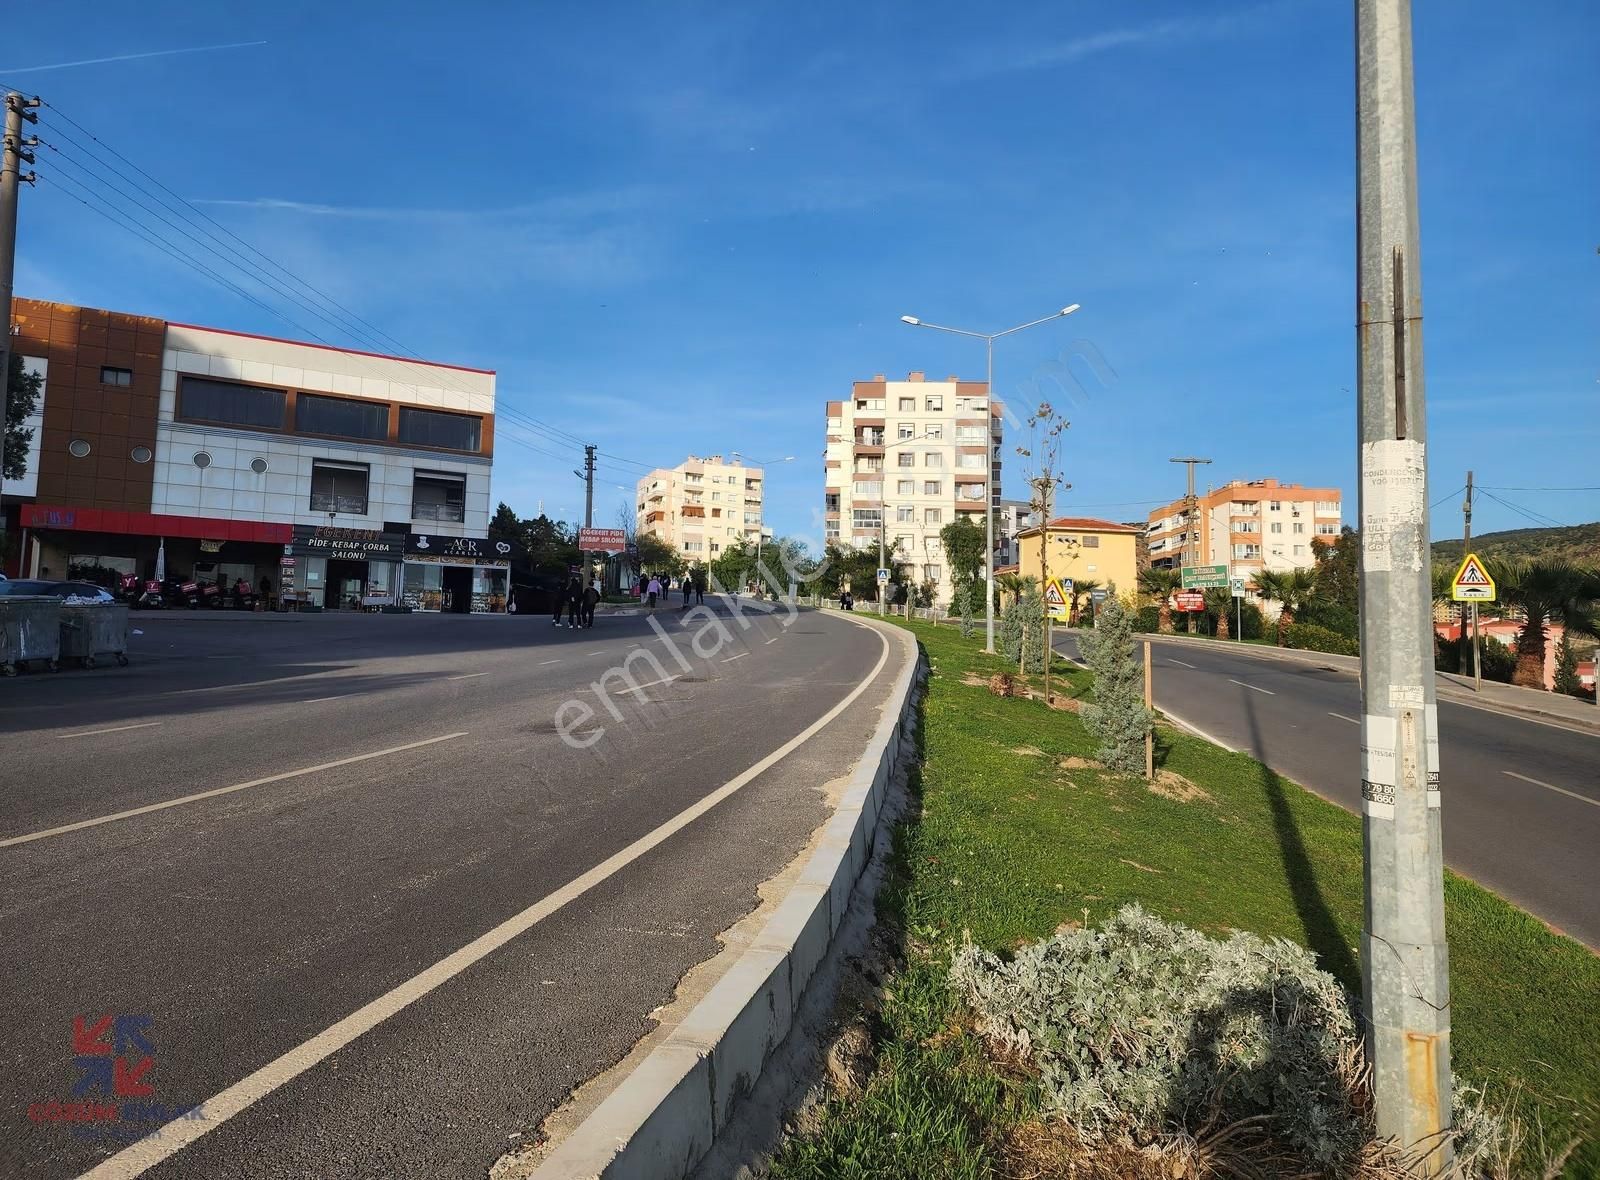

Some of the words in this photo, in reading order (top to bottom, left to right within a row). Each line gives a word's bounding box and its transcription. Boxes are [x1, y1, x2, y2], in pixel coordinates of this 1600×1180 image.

[331, 551, 366, 560] SALONU
[1383, 785, 1395, 795] 80
[1372, 794, 1395, 804] 1660
